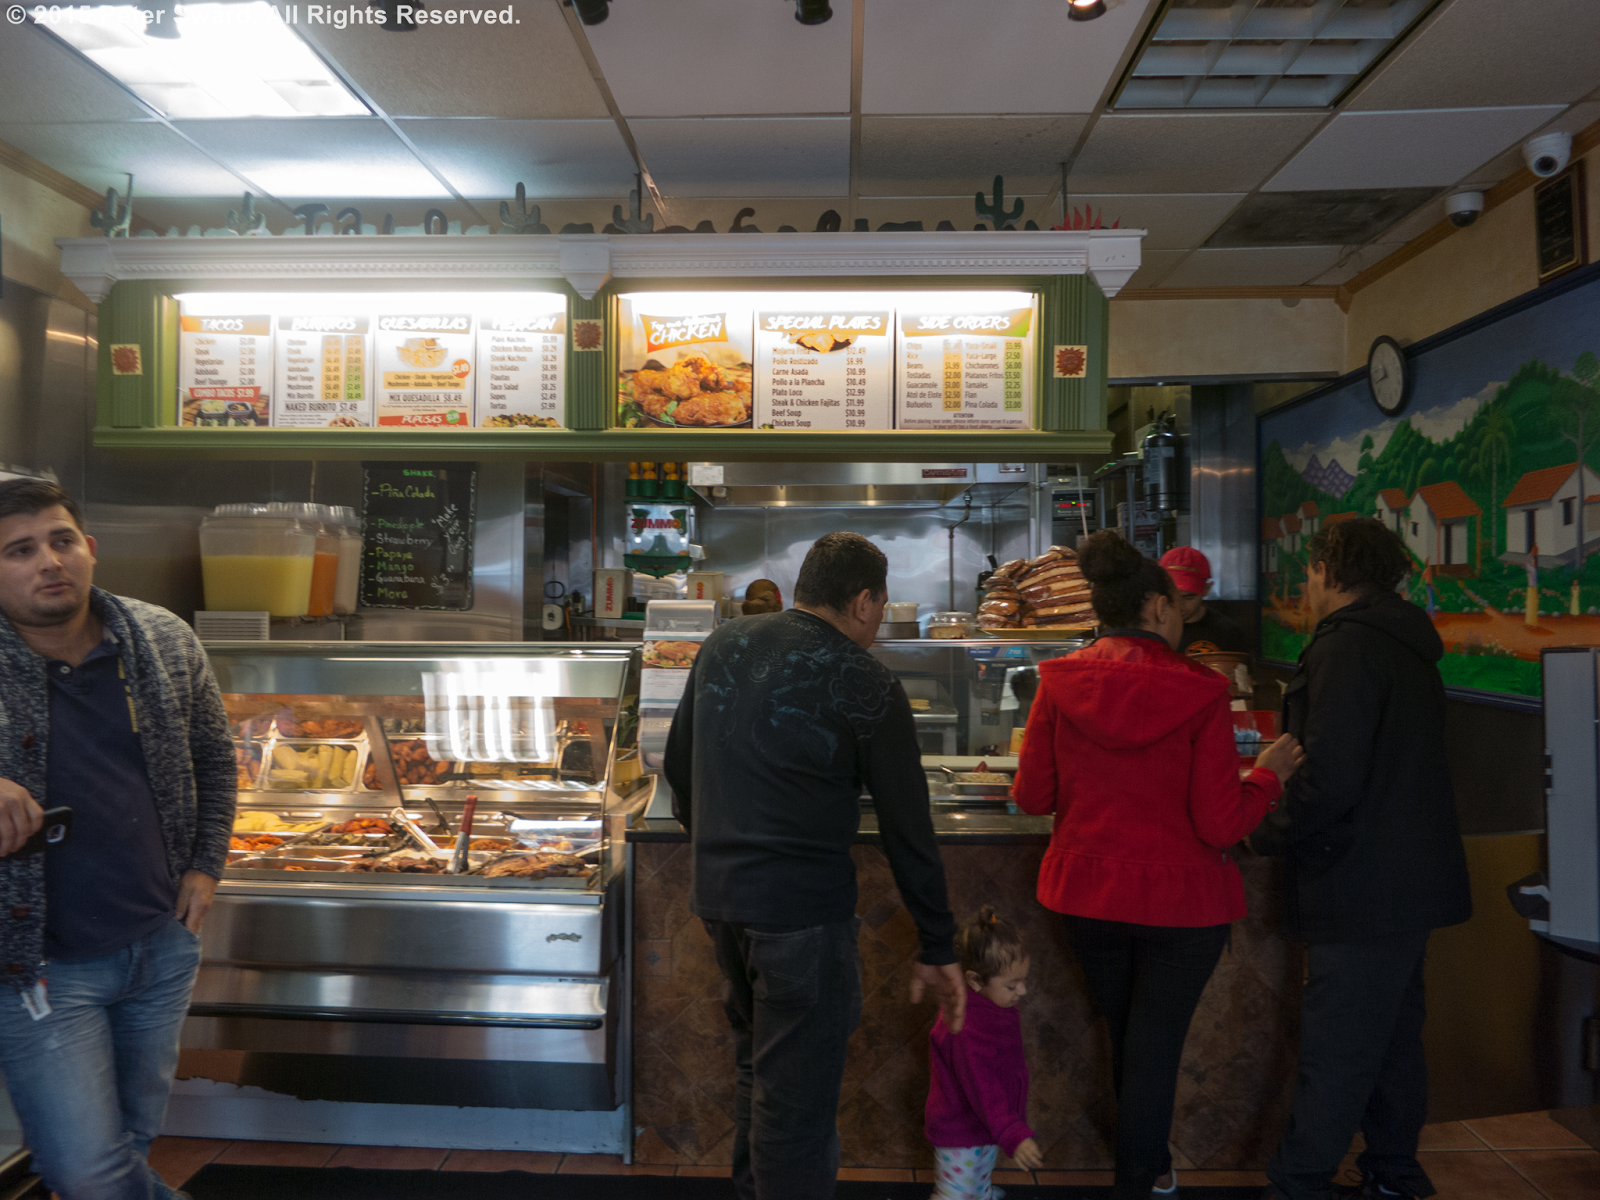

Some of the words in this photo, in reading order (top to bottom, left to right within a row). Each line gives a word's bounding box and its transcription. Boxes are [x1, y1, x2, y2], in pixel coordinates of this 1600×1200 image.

[200, 319, 244, 331] TACOS
[765, 315, 827, 330] SPECIAL
[828, 315, 881, 330] PLATES
[917, 316, 951, 330] SIDE
[952, 316, 1011, 330] ORDERS
[650, 322, 722, 345] CHICKEN
[787, 409, 802, 417] Soup
[796, 420, 811, 428] Soup
[405, 485, 436, 498] Colada
[631, 518, 682, 530] ZUMMO
[375, 547, 413, 561] Papaya
[377, 561, 414, 574] Mango
[377, 587, 408, 599] Mora
[605, 577, 614, 612] ZUMMO
